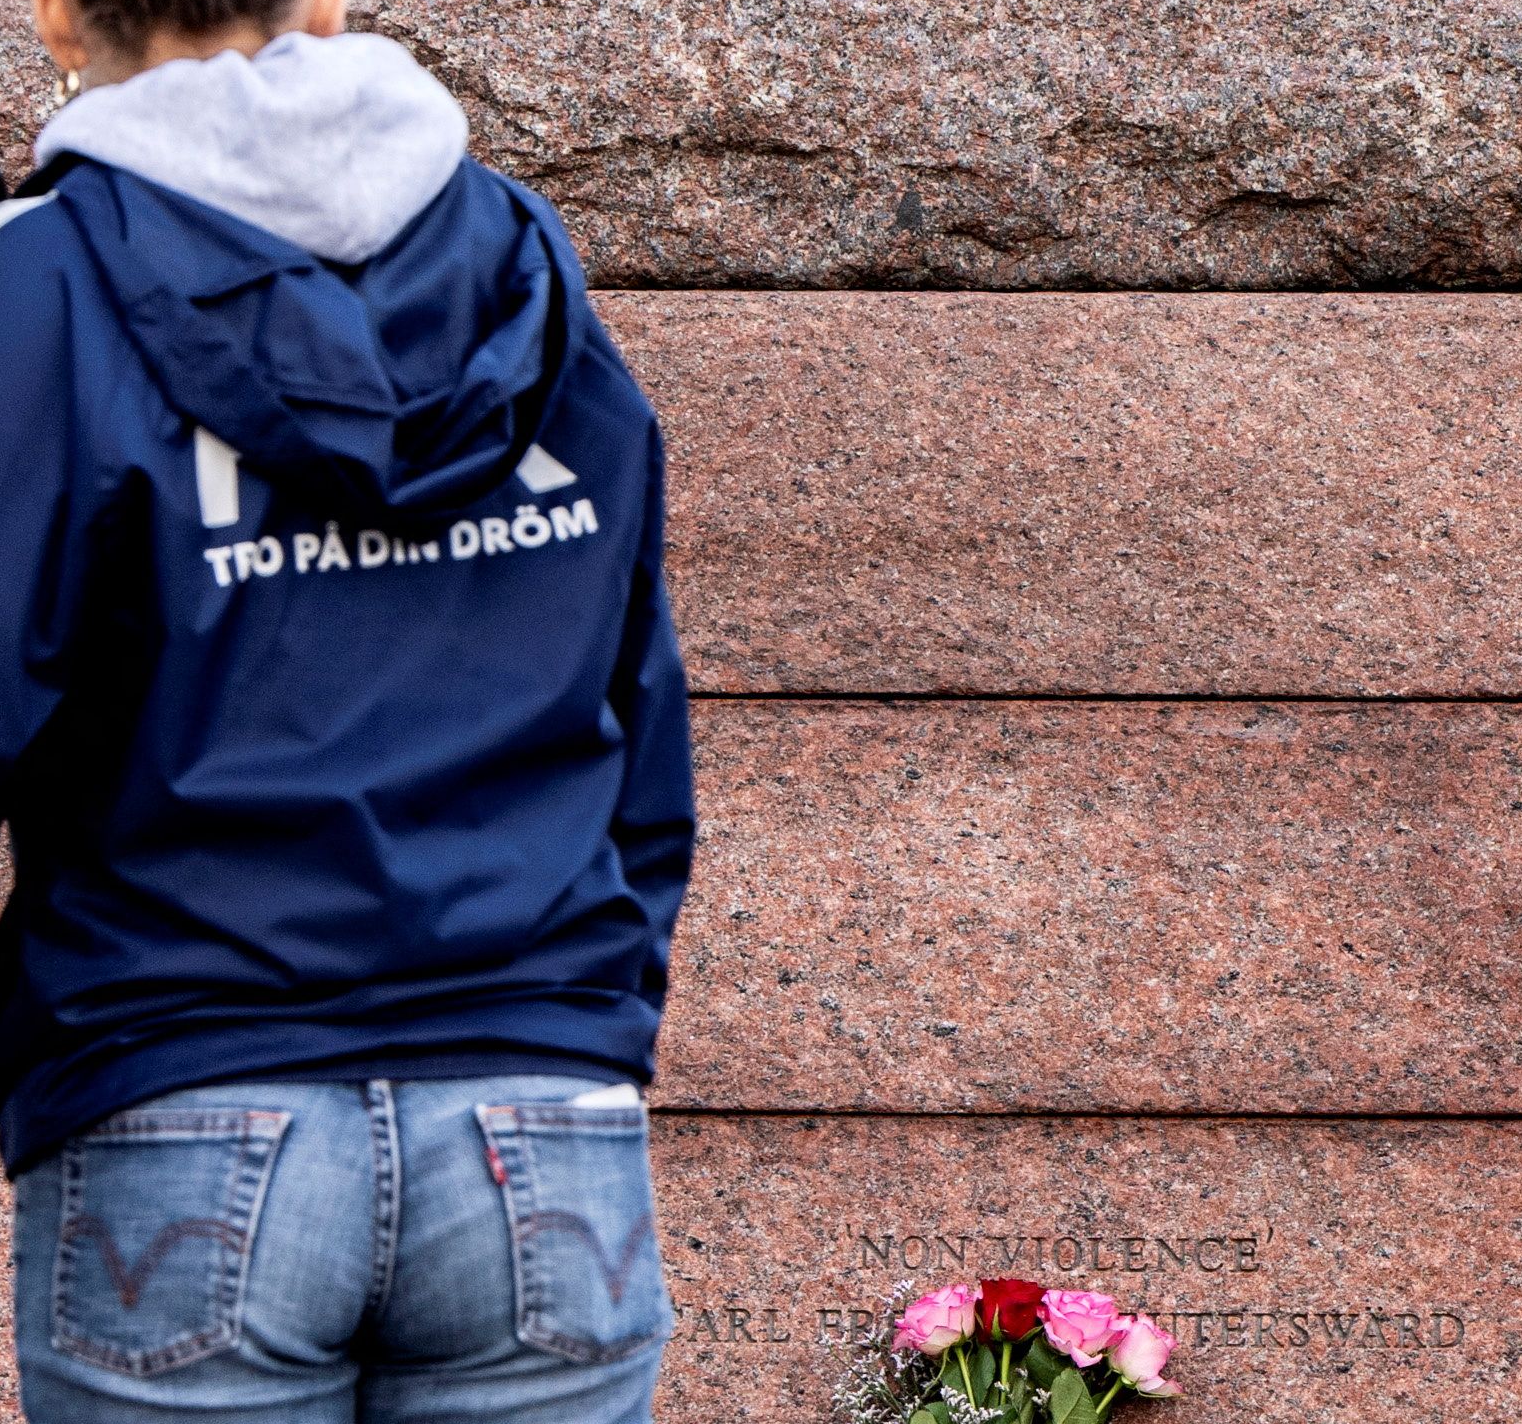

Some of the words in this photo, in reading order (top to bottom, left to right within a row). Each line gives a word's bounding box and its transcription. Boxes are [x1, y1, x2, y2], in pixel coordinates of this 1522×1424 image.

[292, 519, 351, 575] PÅ
[449, 498, 600, 561] DRÖM
[671, 1307, 791, 1344] ARL
